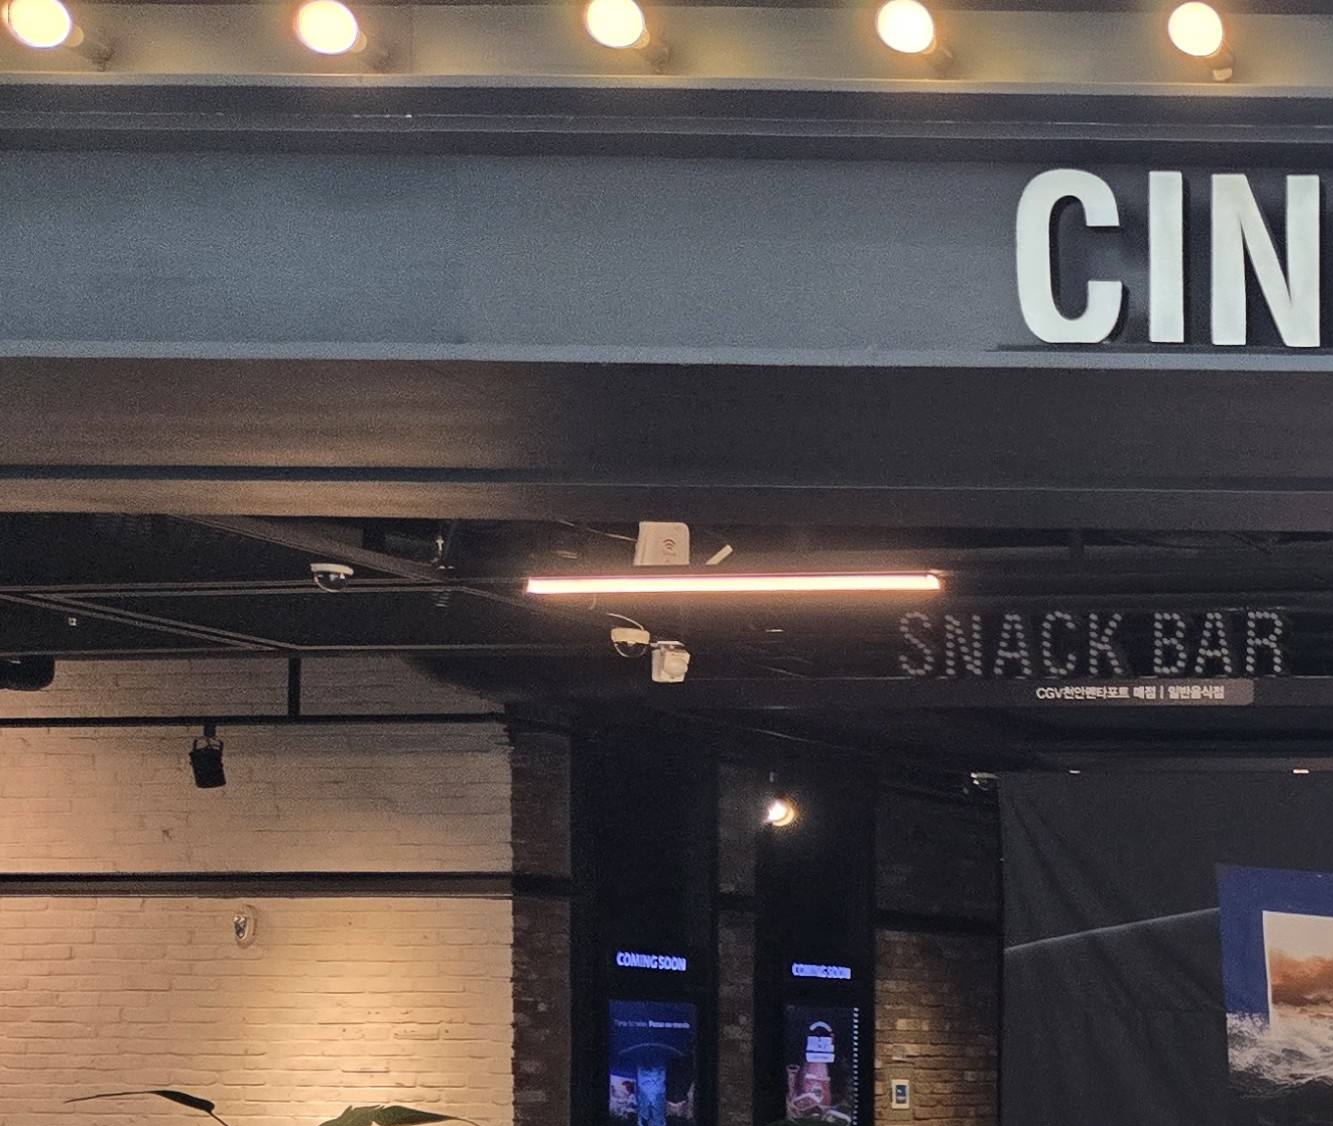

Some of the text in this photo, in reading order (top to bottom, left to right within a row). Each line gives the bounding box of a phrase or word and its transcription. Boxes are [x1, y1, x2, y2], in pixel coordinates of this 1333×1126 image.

[899, 610, 1284, 676] SNACK BAR
[616, 951, 687, 972] COMING SOON
